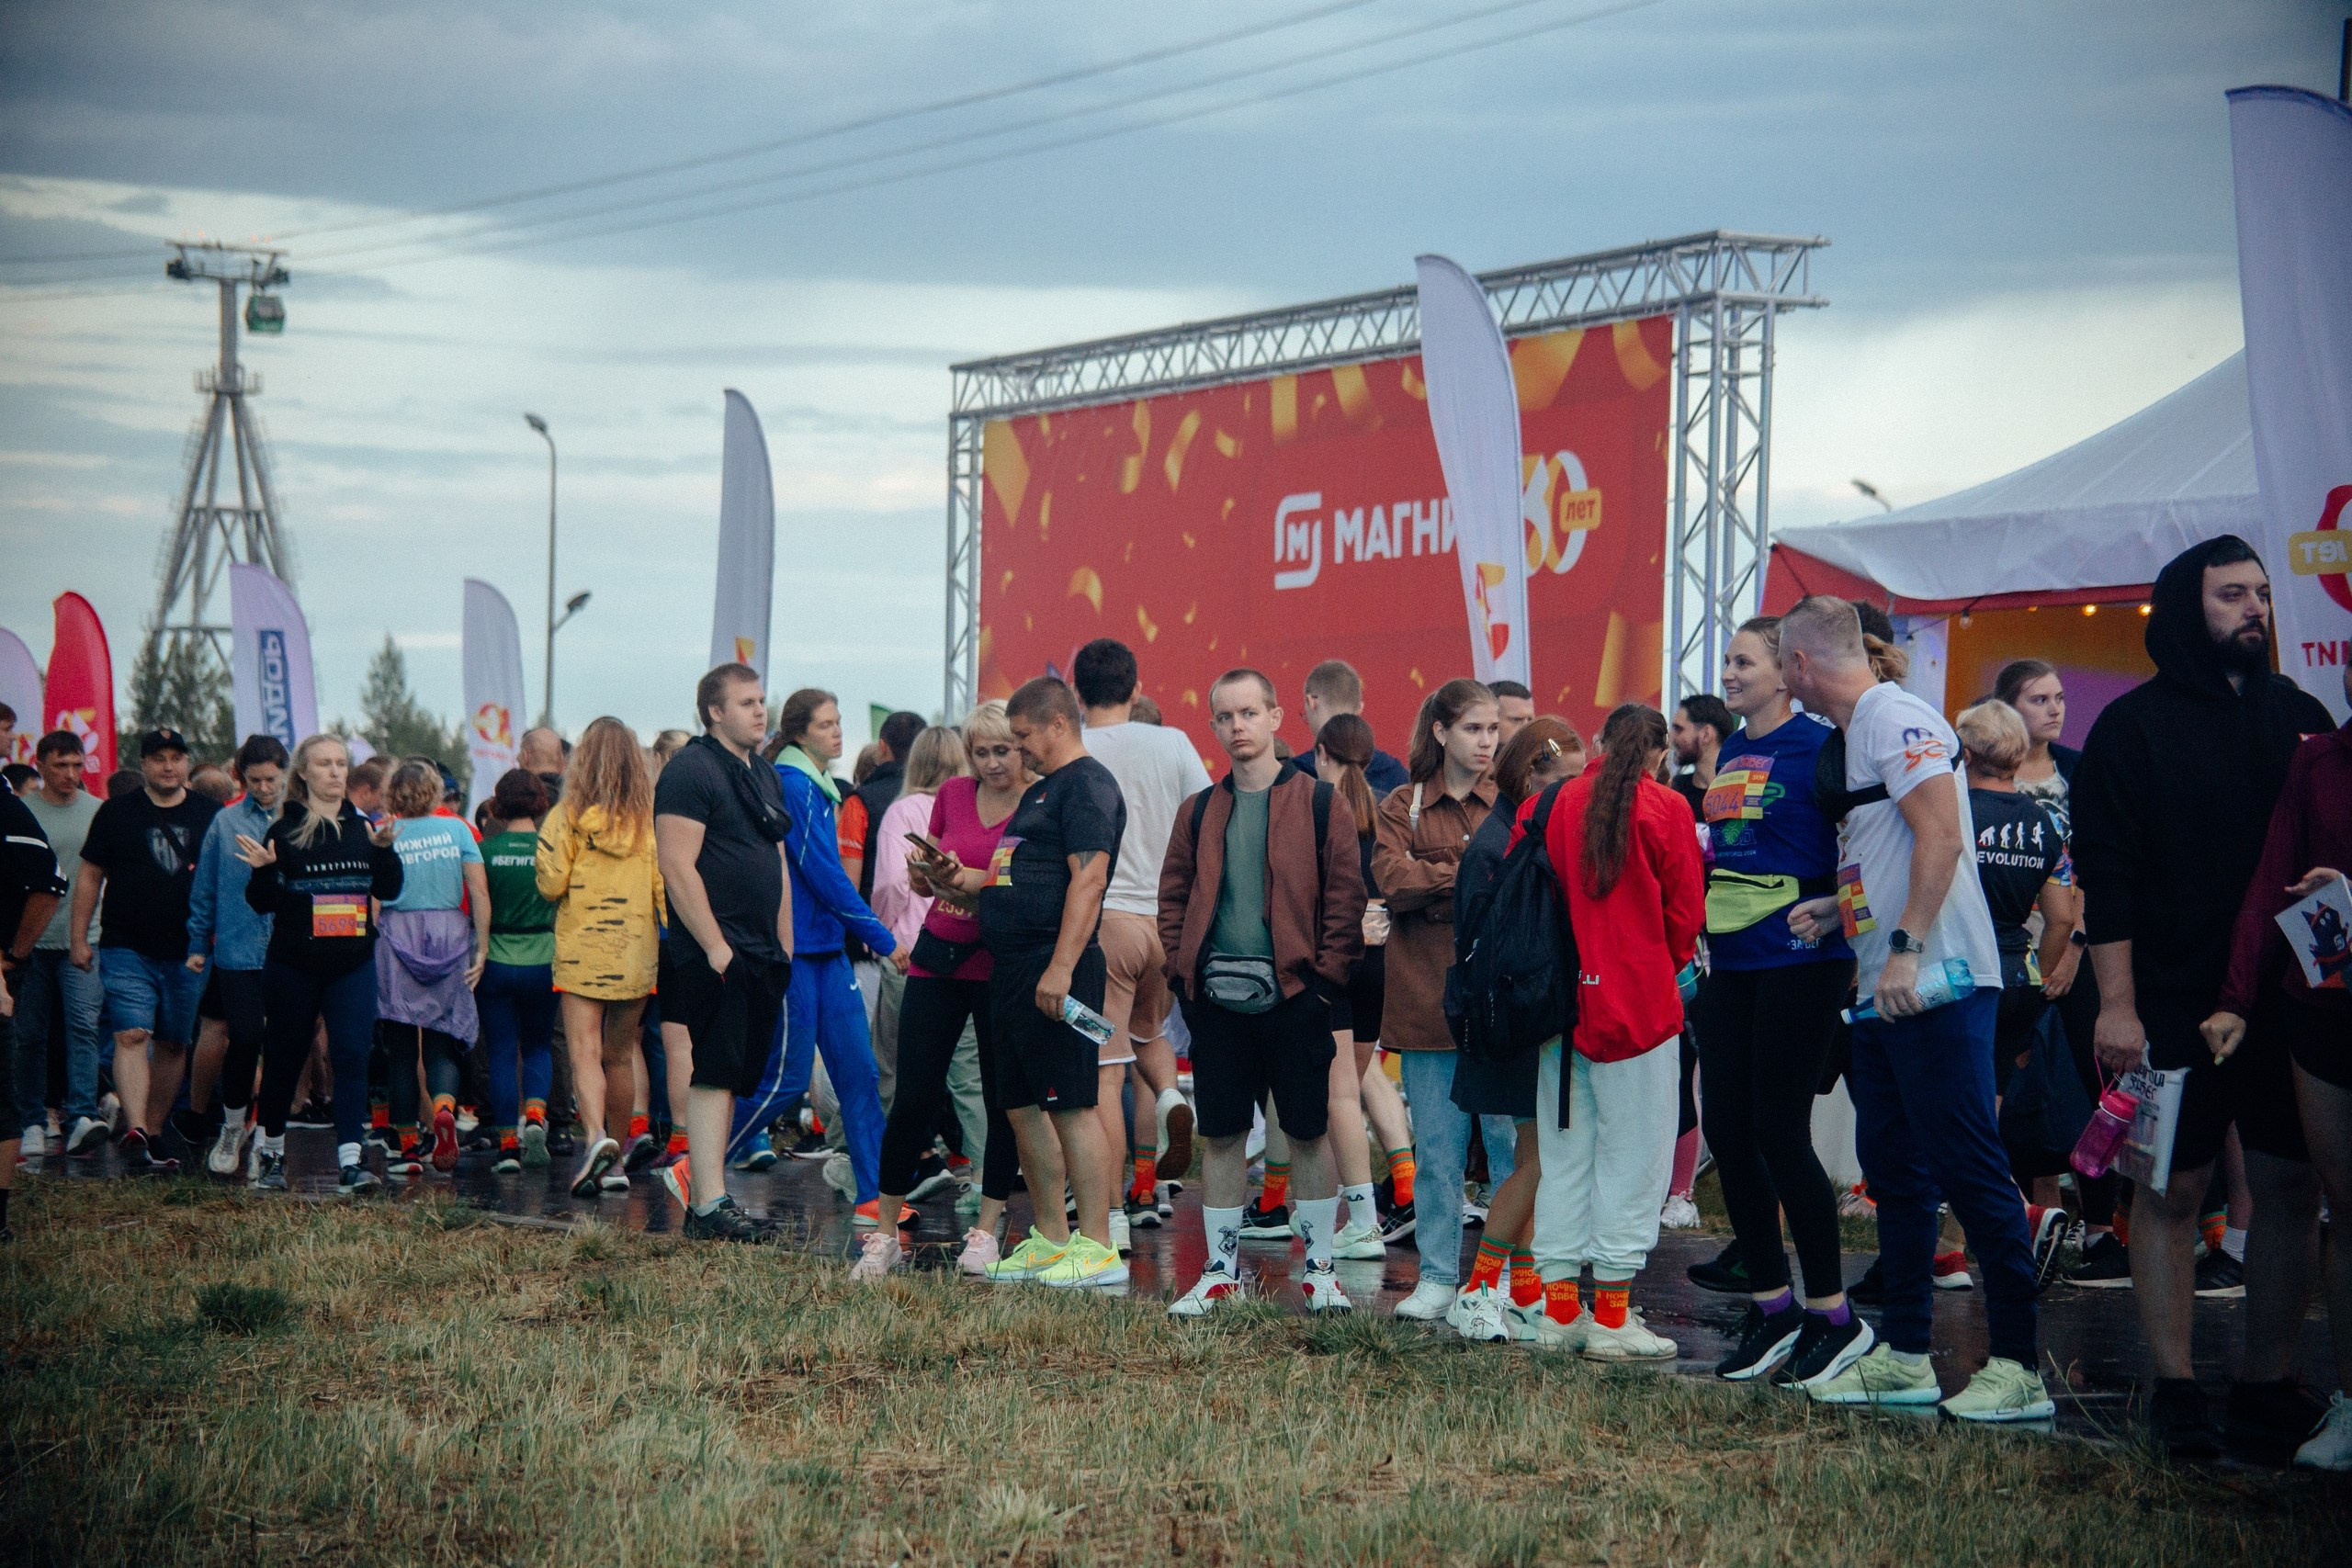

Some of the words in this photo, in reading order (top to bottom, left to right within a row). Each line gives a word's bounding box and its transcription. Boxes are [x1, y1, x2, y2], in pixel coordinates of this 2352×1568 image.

[1334, 497, 1457, 564] МАГНИ
[399, 845, 460, 865] ОВГОРОД
[1976, 851, 2045, 870] EVOLUTION
